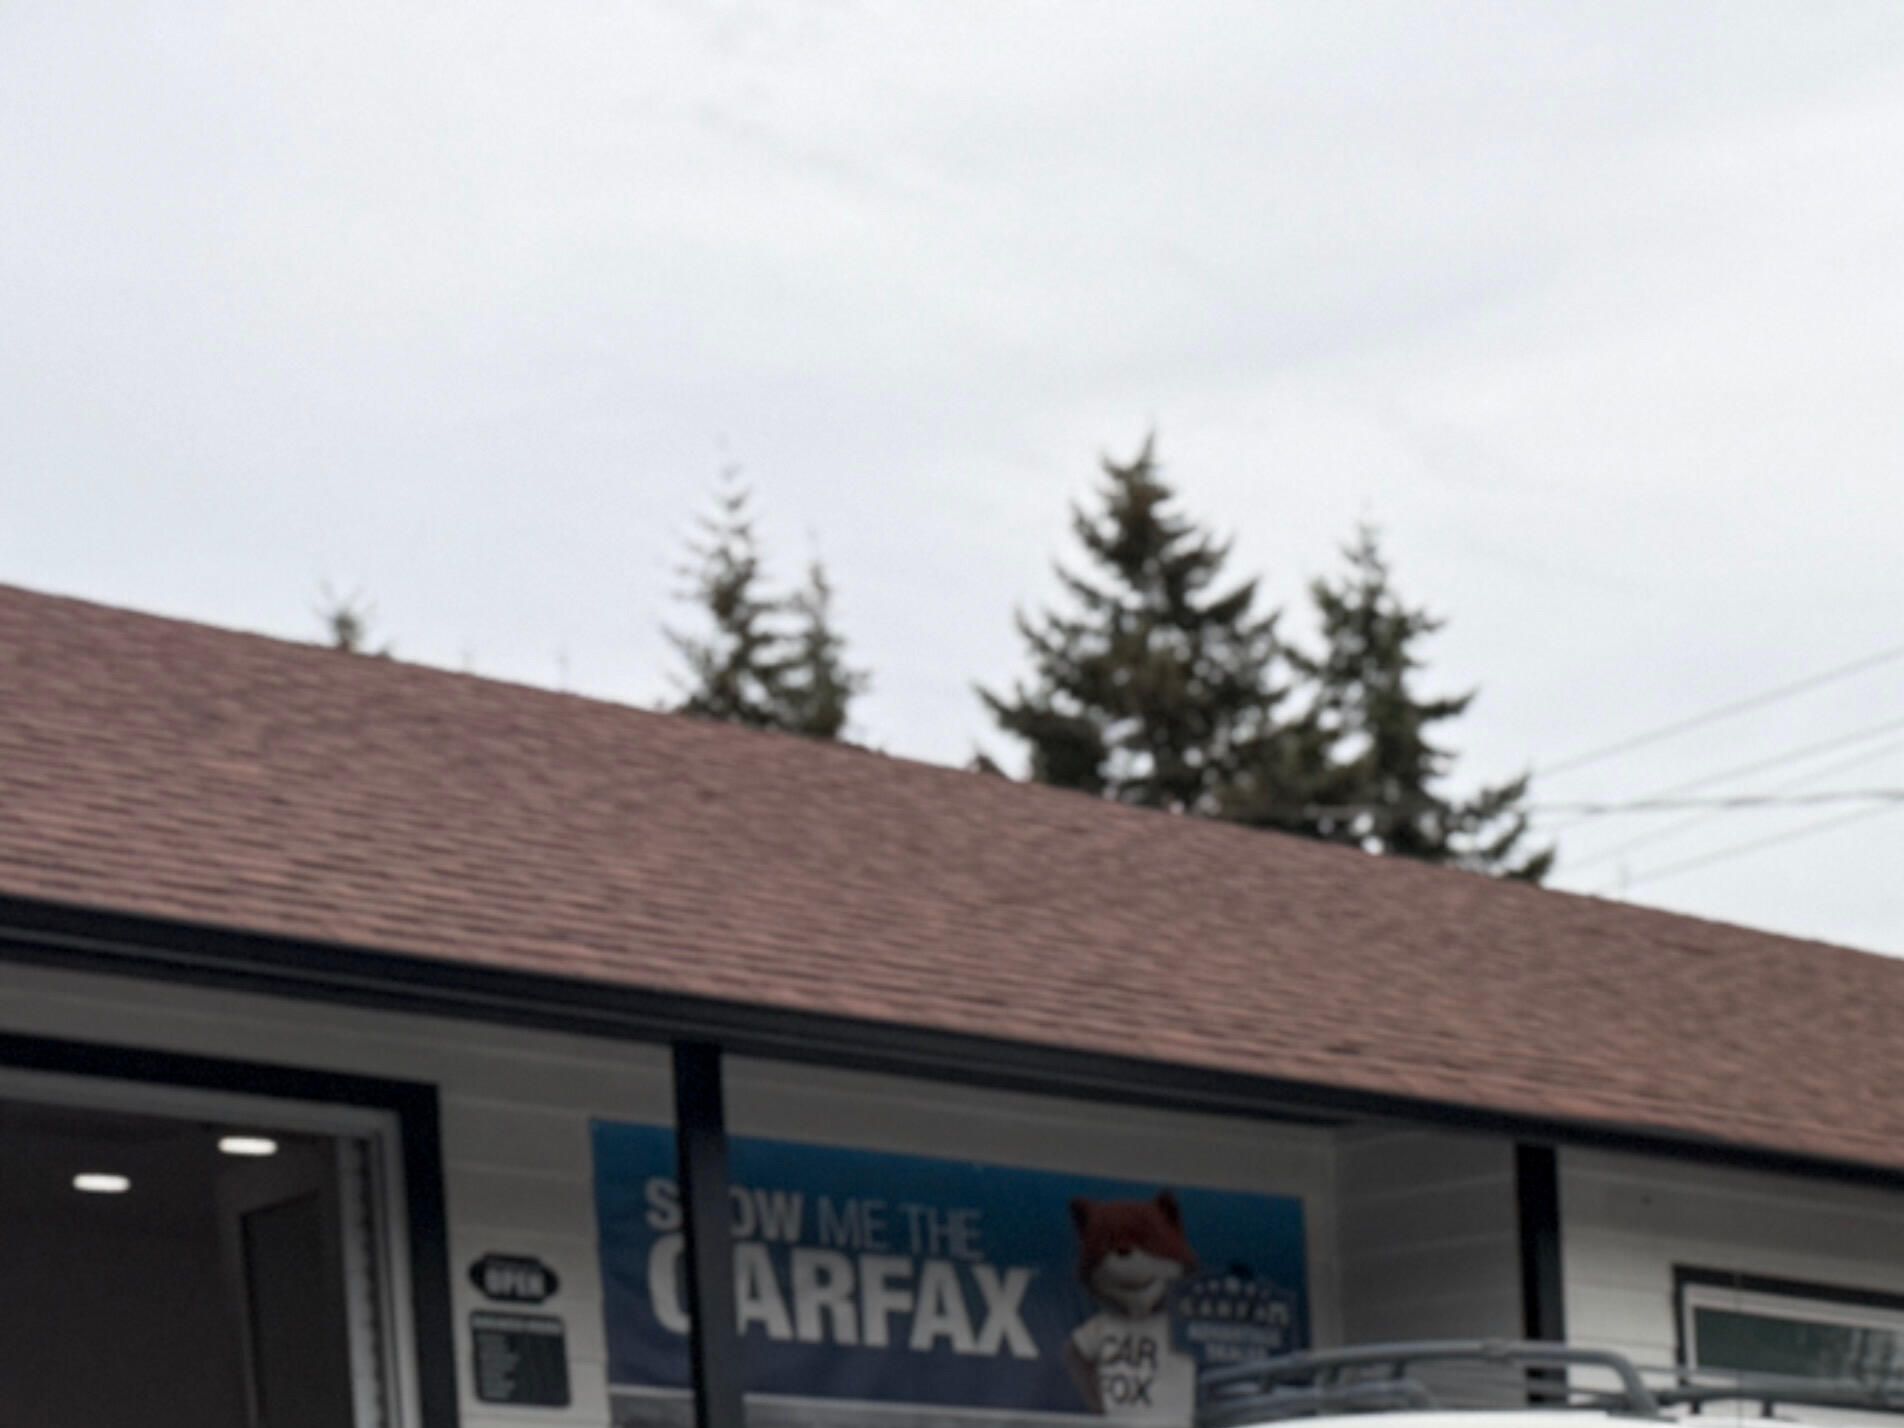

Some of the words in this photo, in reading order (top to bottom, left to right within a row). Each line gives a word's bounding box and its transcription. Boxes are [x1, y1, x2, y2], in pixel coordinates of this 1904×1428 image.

[817, 1197, 886, 1249] ME
[904, 1204, 984, 1259] THE
[1100, 1335, 1156, 1369] CAR
